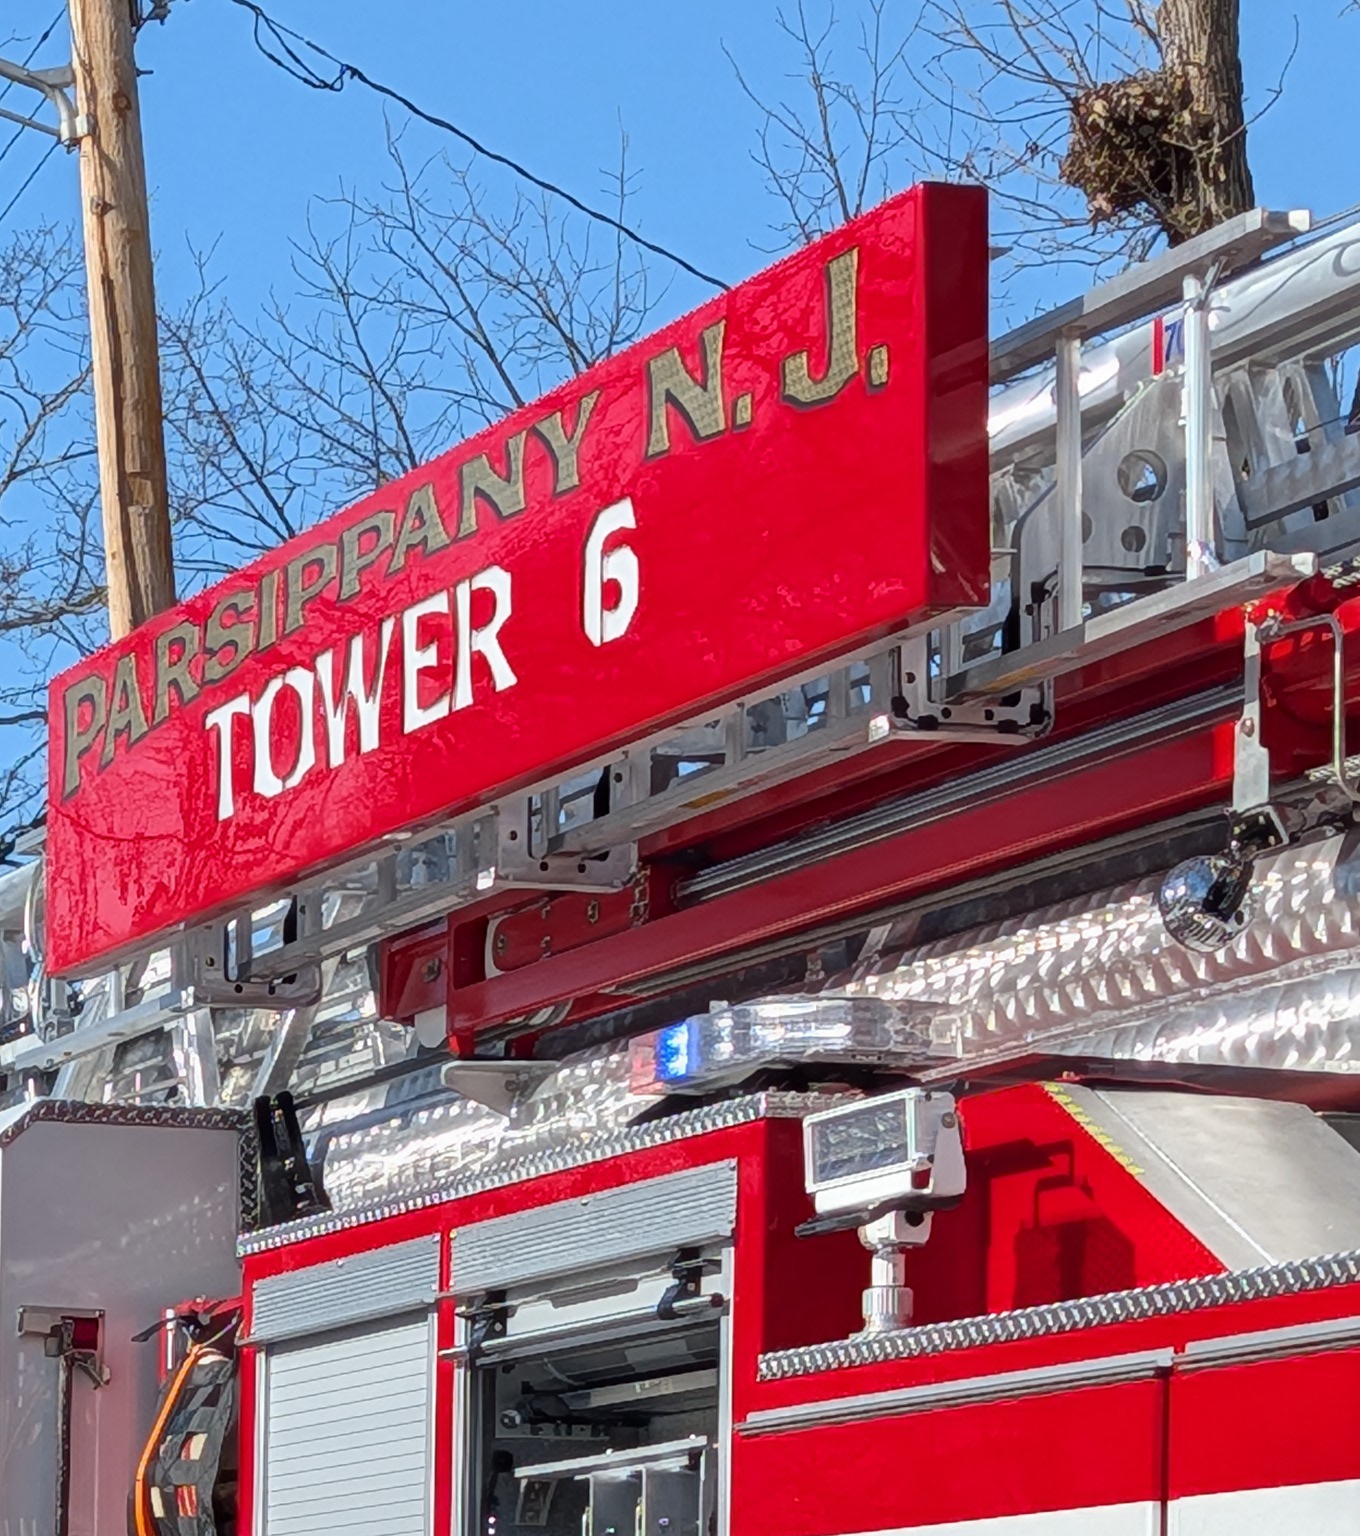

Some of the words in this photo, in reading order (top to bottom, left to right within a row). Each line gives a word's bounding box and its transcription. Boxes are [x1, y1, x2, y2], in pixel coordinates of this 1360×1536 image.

[60, 388, 601, 803] PARSIPPANY
[205, 564, 518, 822] TOWER
[582, 496, 640, 647] 6
